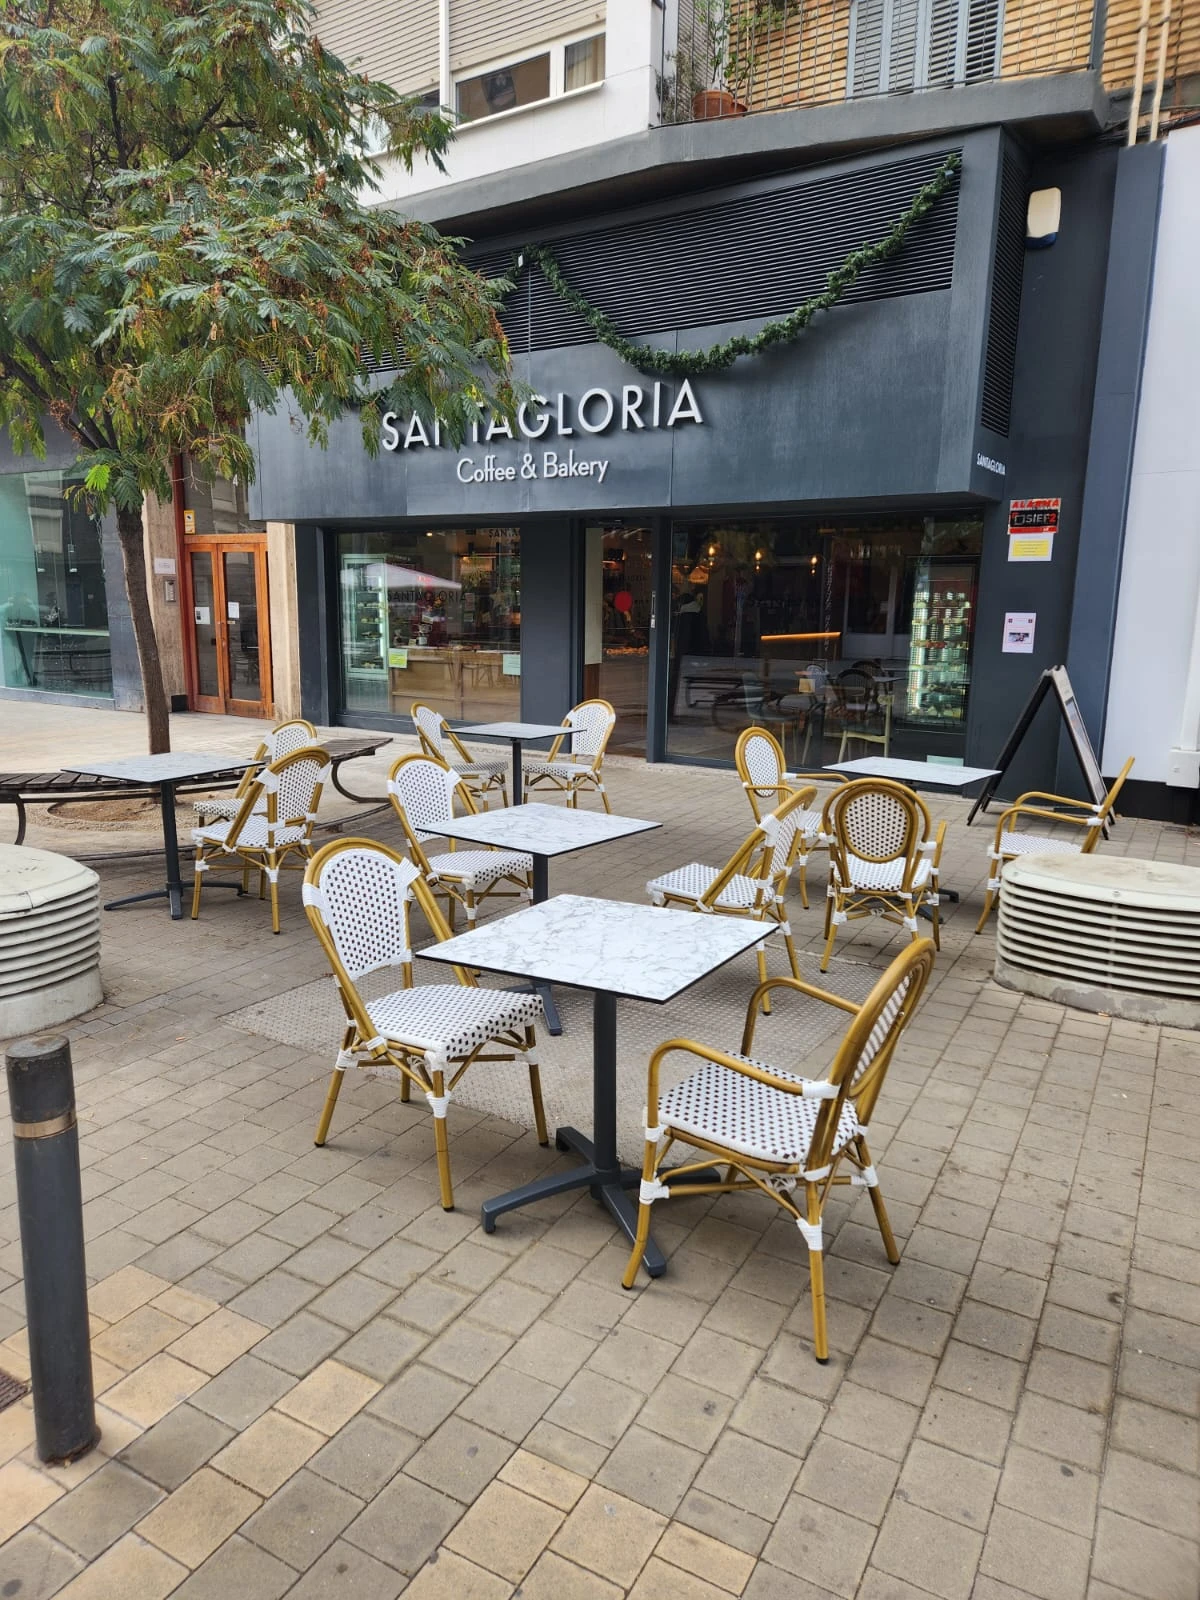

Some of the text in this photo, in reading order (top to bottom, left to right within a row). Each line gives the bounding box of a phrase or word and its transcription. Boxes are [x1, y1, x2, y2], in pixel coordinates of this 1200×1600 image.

[457, 449, 609, 483] Coffee & Bakery
